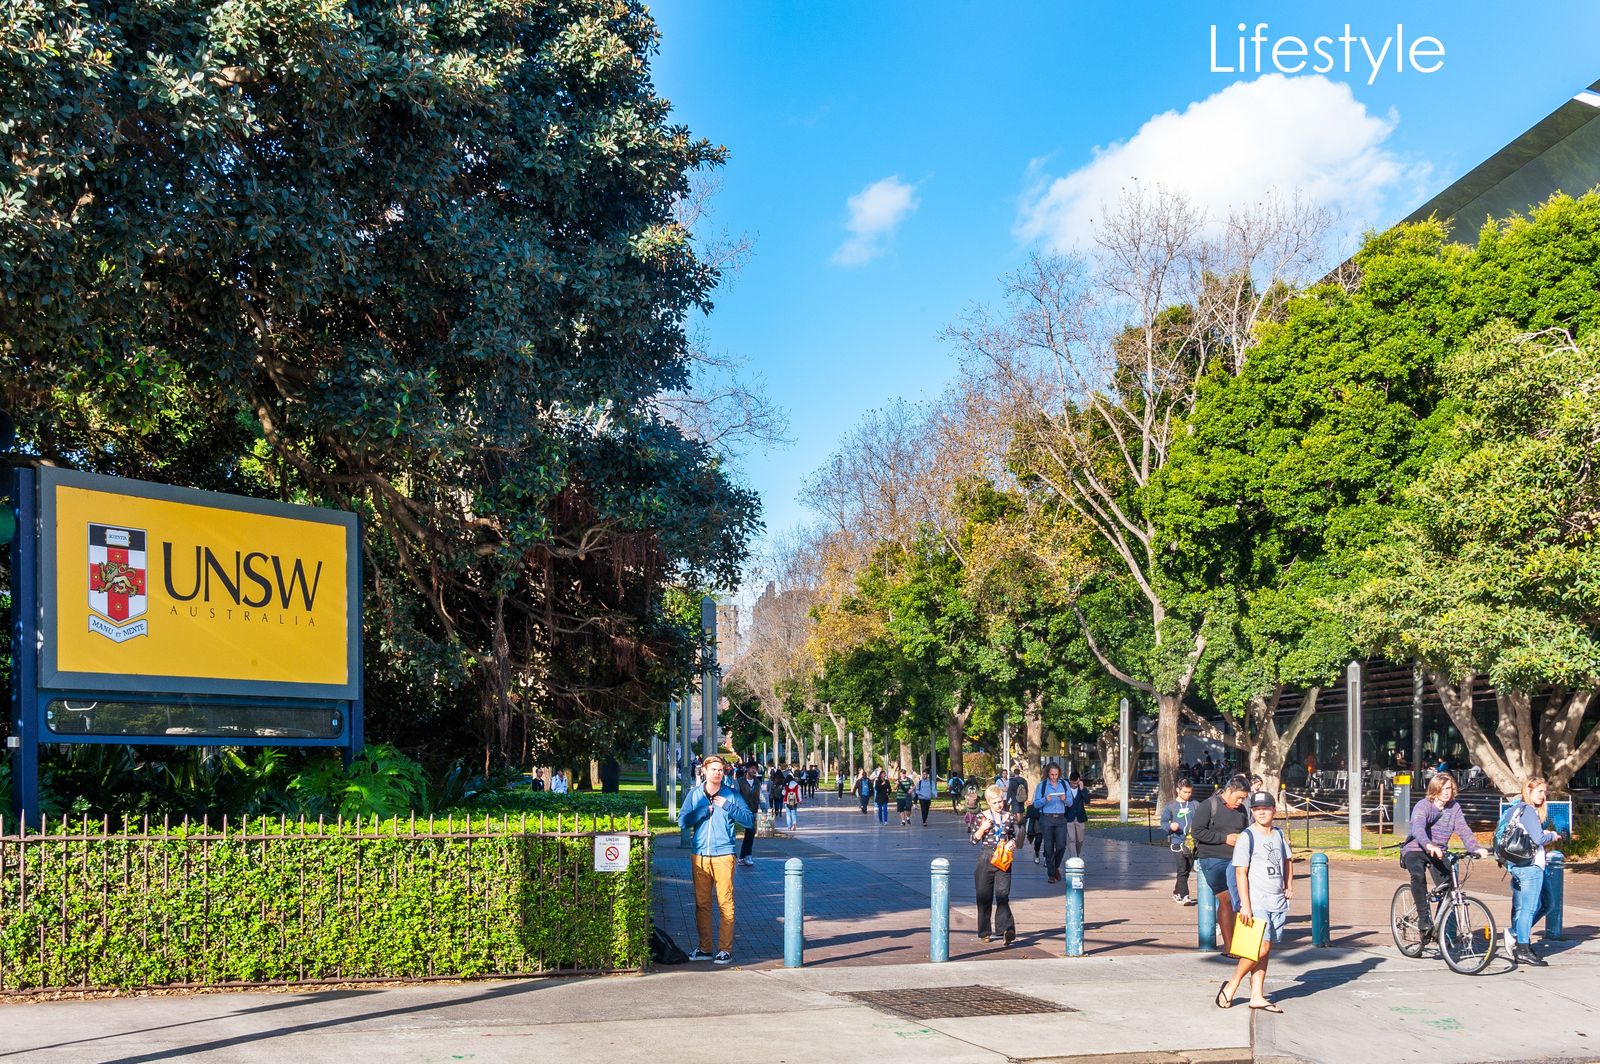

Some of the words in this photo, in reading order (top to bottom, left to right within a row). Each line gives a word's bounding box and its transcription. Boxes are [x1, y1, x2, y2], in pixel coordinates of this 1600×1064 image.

[162, 541, 323, 612] UNSW
[170, 605, 316, 627] AUSTRALIA
[92, 620, 114, 635] MANU
[122, 623, 145, 637] MENTE
